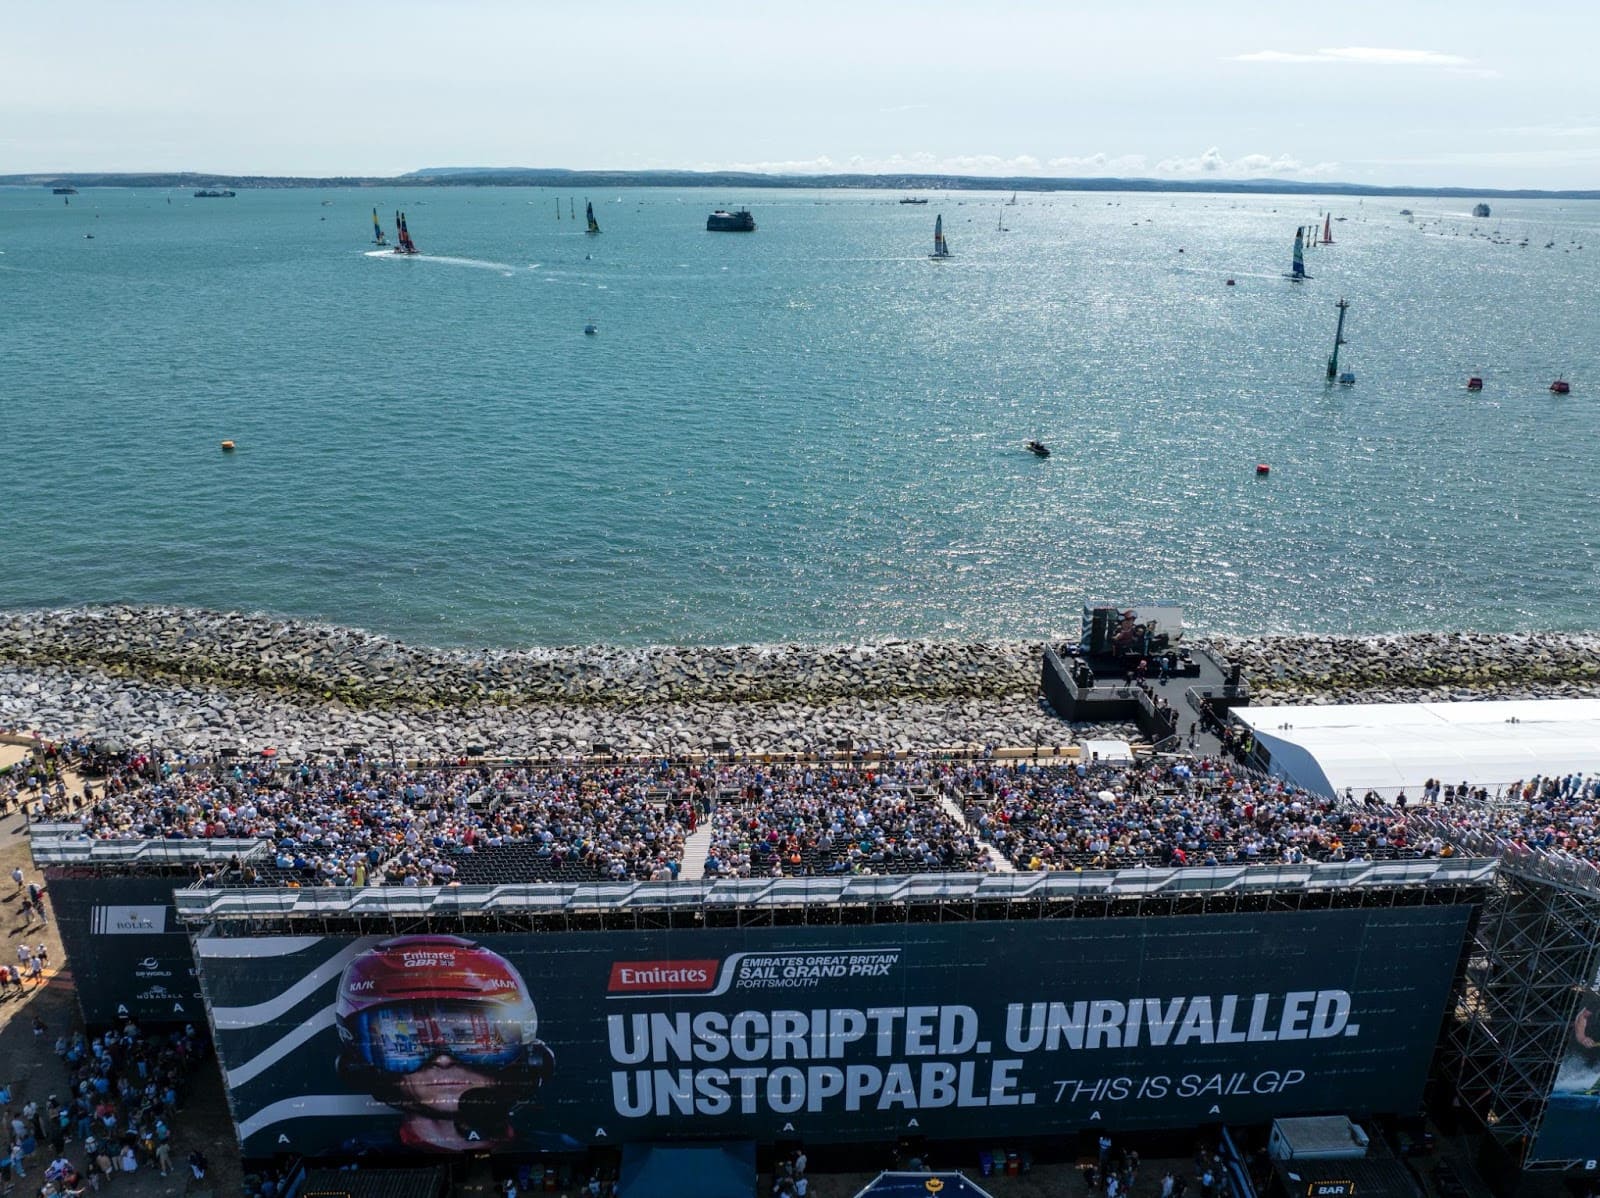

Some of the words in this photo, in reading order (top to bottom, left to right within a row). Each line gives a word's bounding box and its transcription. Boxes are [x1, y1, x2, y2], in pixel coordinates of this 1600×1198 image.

[403, 952, 455, 961] Emirates
[742, 957, 803, 967] EMIRATES
[806, 956, 848, 965] GREAT
[849, 954, 898, 964] BRITAIN
[621, 967, 707, 984] Emirates
[739, 966, 779, 979] SAIL
[783, 965, 847, 978] GRAND
[849, 964, 891, 976] PRIX
[736, 978, 818, 988] PORTSMOUTH
[118, 1004, 128, 1014] A
[174, 1002, 184, 1012] A
[607, 1005, 992, 1064] UNSCRIPTED.
[1005, 990, 1360, 1052] UNRIVALLED.
[611, 1060, 1036, 1118] UNSTOPPABLE.
[1053, 1077, 1132, 1102] THIS
[1136, 1076, 1172, 1099] IS
[1176, 1070, 1305, 1098] SAILGP
[1208, 1104, 1220, 1114] A
[1090, 1110, 1102, 1120] A
[784, 1122, 794, 1132] A
[908, 1118, 920, 1128] A
[468, 1130, 480, 1140] A
[594, 1128, 606, 1136] A
[278, 1134, 290, 1144] A
[1584, 1159, 1598, 1170] B
[1318, 1186, 1345, 1195] BAR
